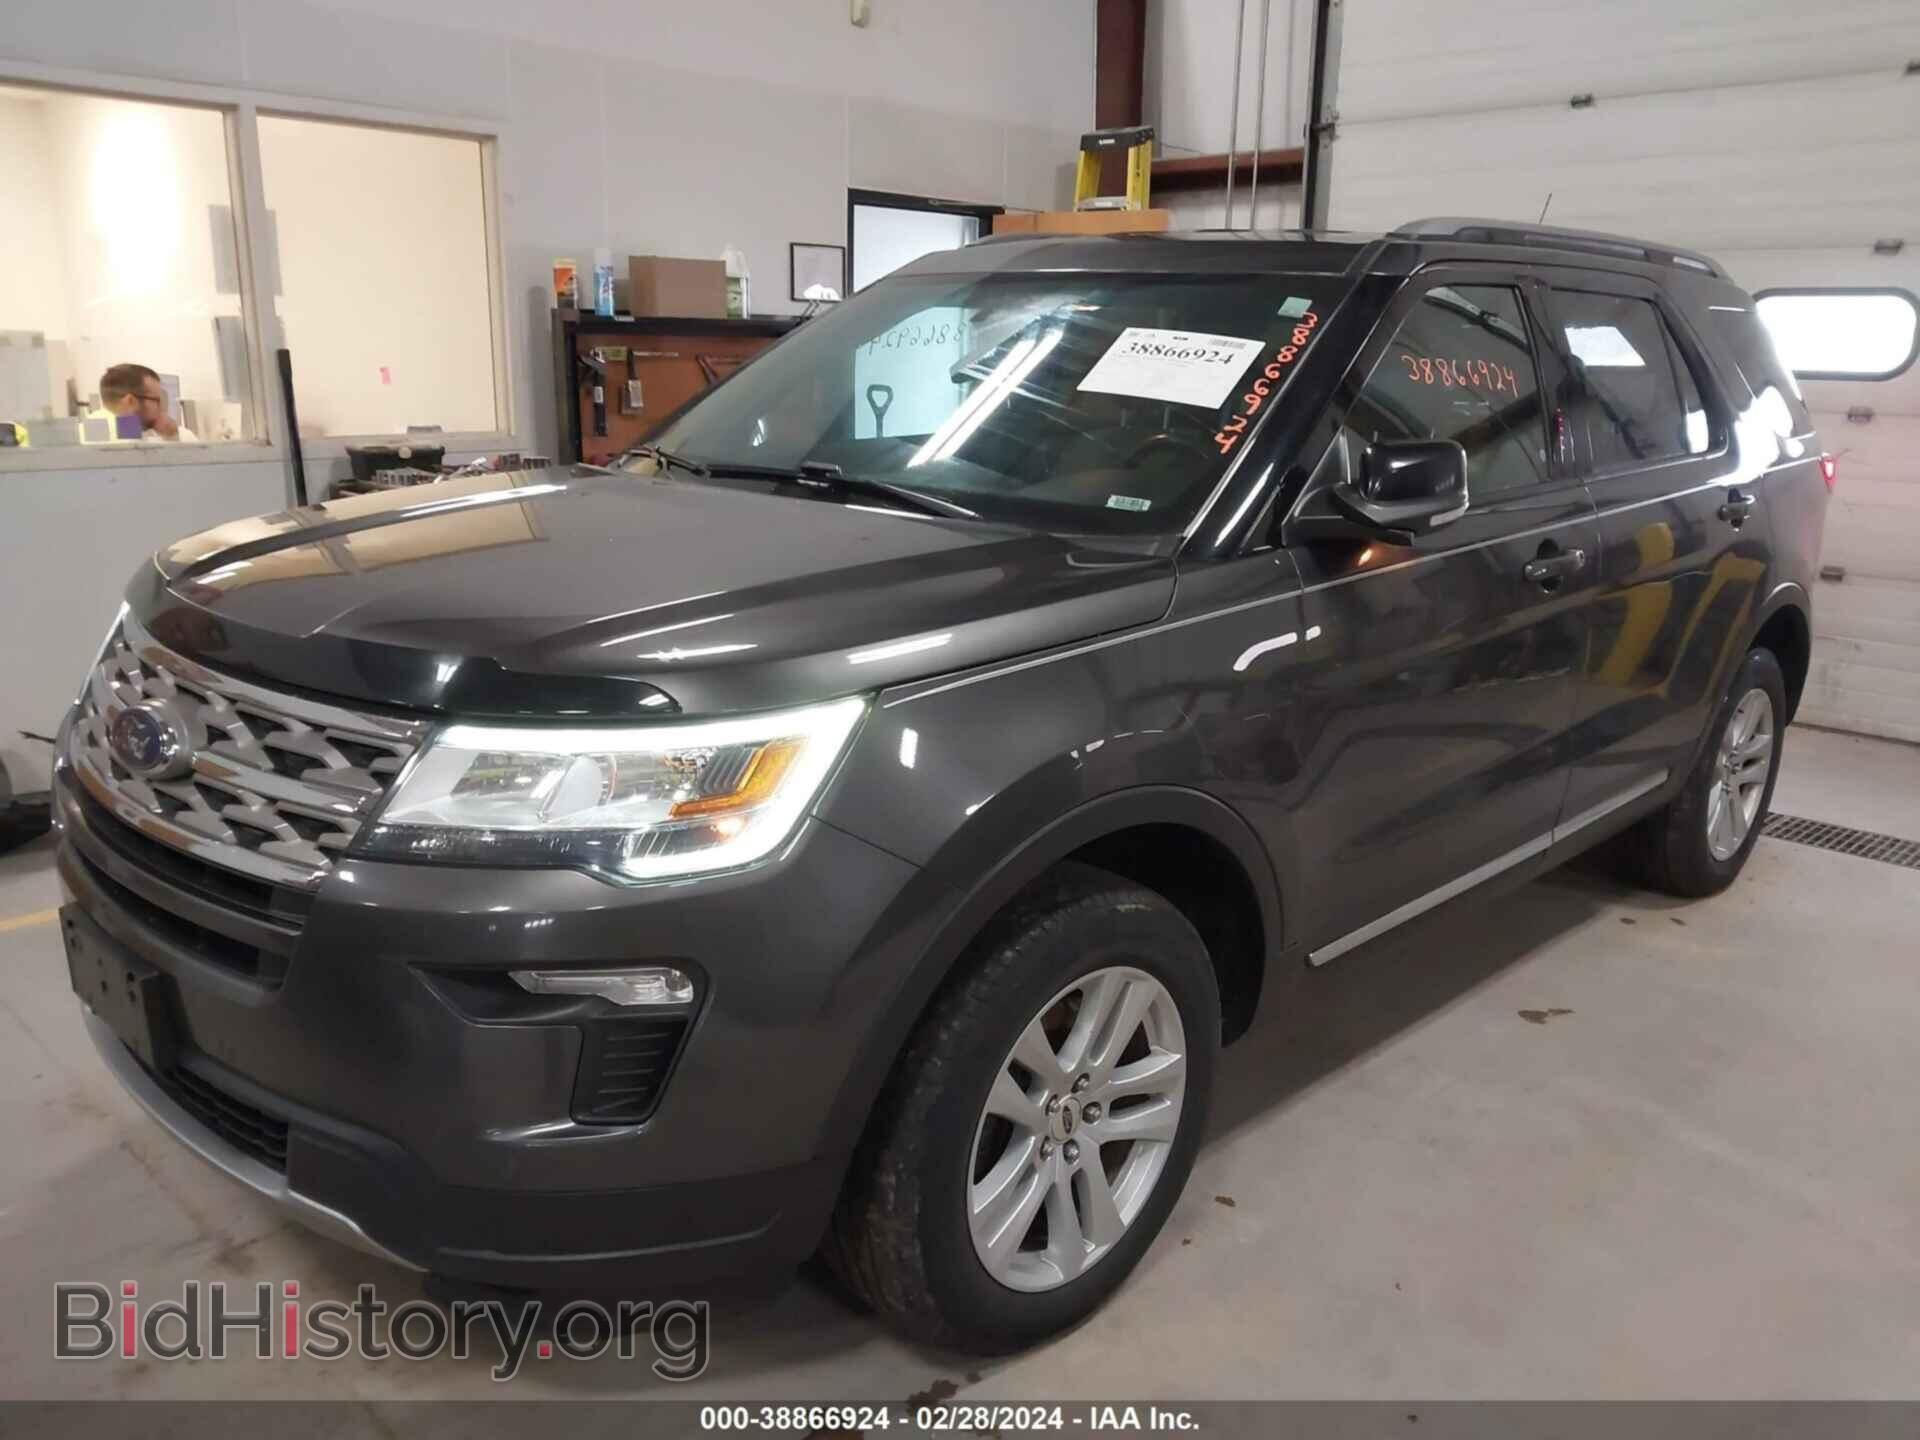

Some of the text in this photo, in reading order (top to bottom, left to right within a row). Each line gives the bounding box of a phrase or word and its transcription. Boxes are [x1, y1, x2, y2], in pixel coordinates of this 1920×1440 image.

[1121, 341, 1235, 366] 38866924
[1213, 311, 1319, 455] 38866924
[1400, 354, 1519, 399] 38866924
